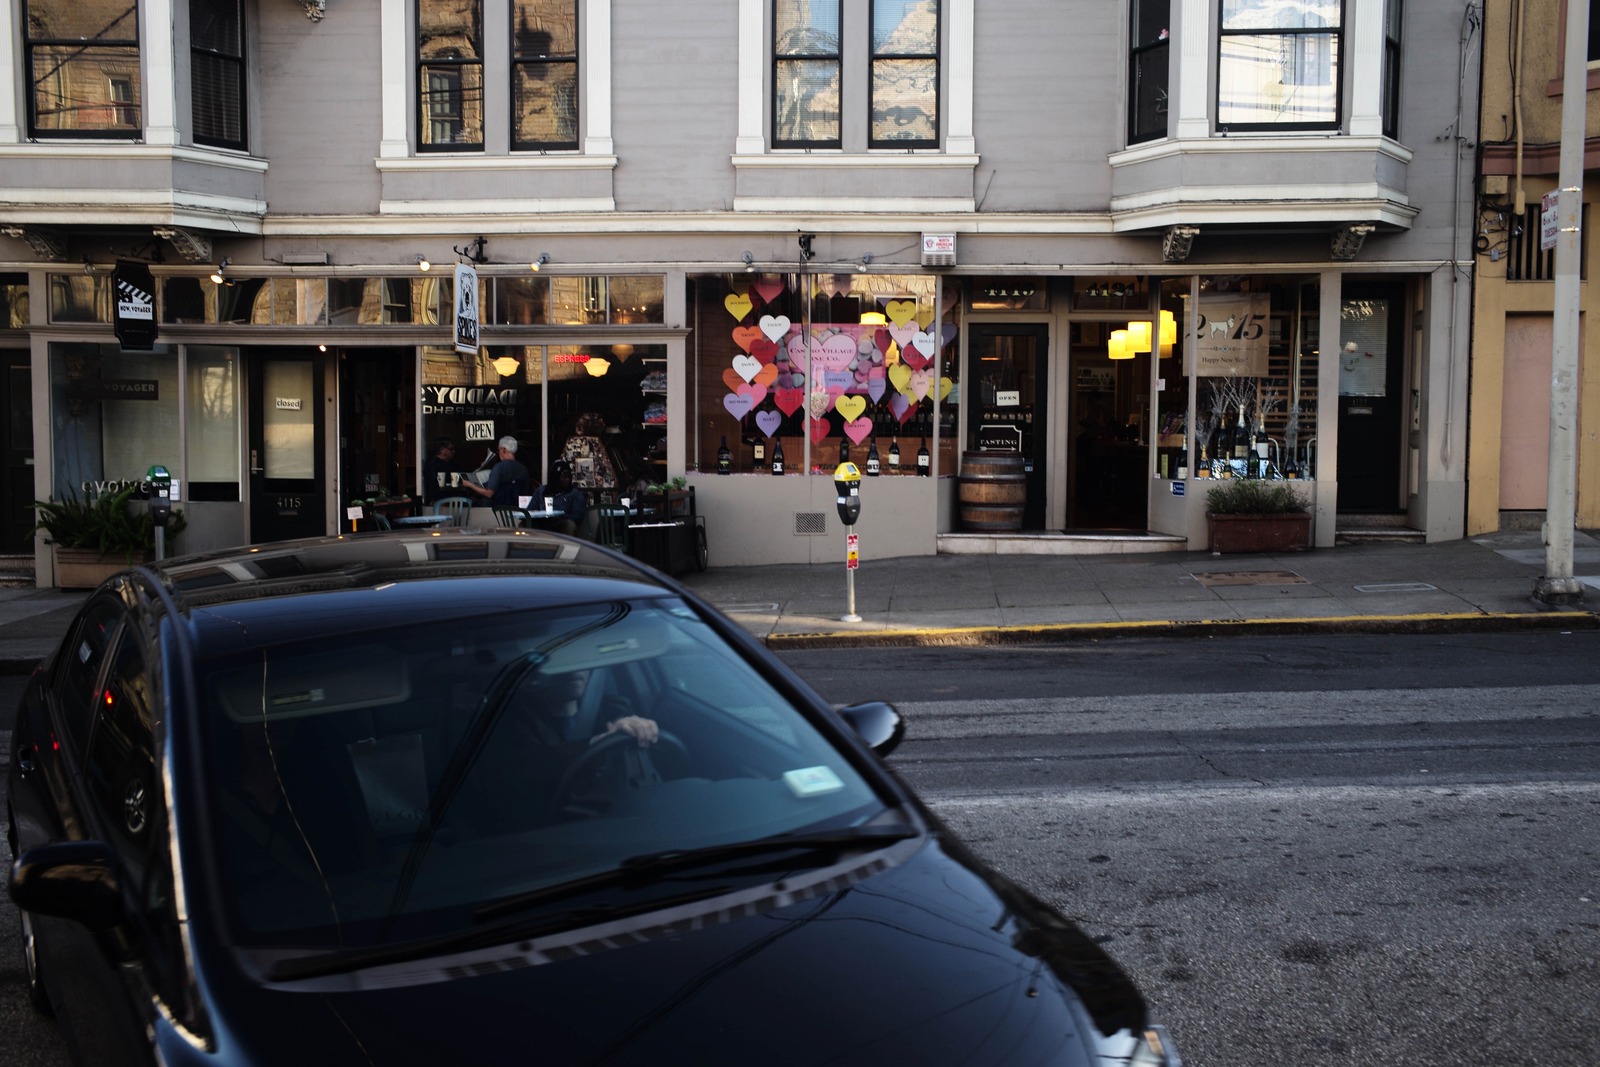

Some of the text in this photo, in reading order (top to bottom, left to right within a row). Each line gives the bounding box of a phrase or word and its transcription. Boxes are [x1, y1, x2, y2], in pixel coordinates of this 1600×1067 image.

[821, 347, 854, 355] VILLAGE
[554, 354, 591, 363] ESPRESS
[1202, 356, 1219, 364] Happy
[103, 383, 156, 393] VOYAGER
[276, 399, 300, 408] closed
[467, 423, 493, 440] OPEN
[276, 497, 302, 508] 4115
